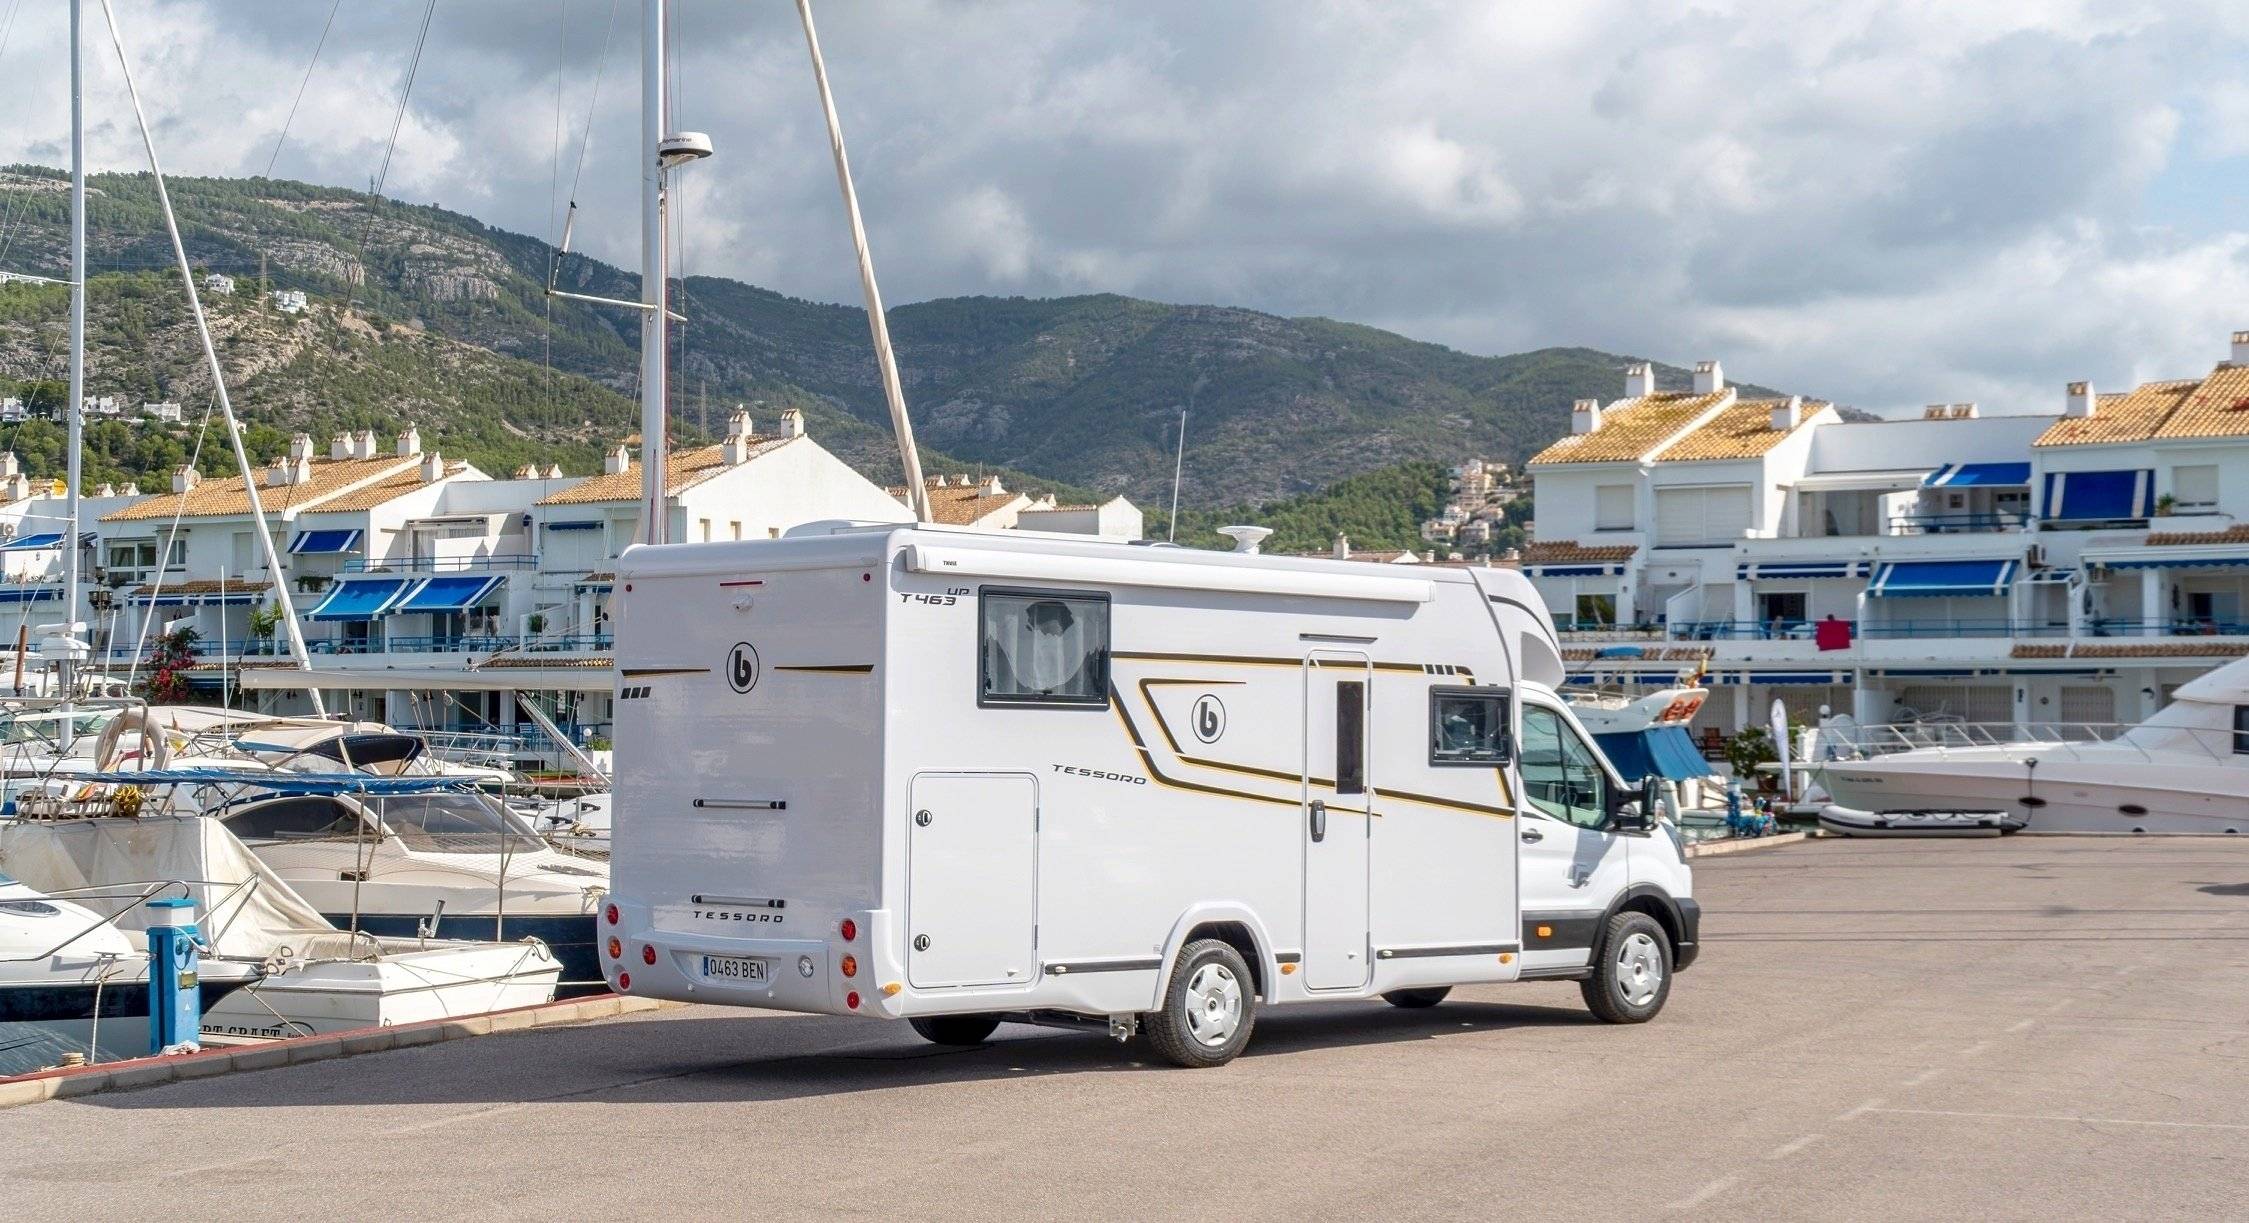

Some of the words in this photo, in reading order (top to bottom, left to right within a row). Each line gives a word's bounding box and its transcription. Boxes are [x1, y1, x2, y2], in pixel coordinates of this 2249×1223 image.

[947, 587, 970, 596] UP
[1052, 764, 1147, 785] TESSORO
[693, 910, 784, 924] TESSORO
[710, 959, 739, 977] 0463
[741, 961, 764, 980] BEN
